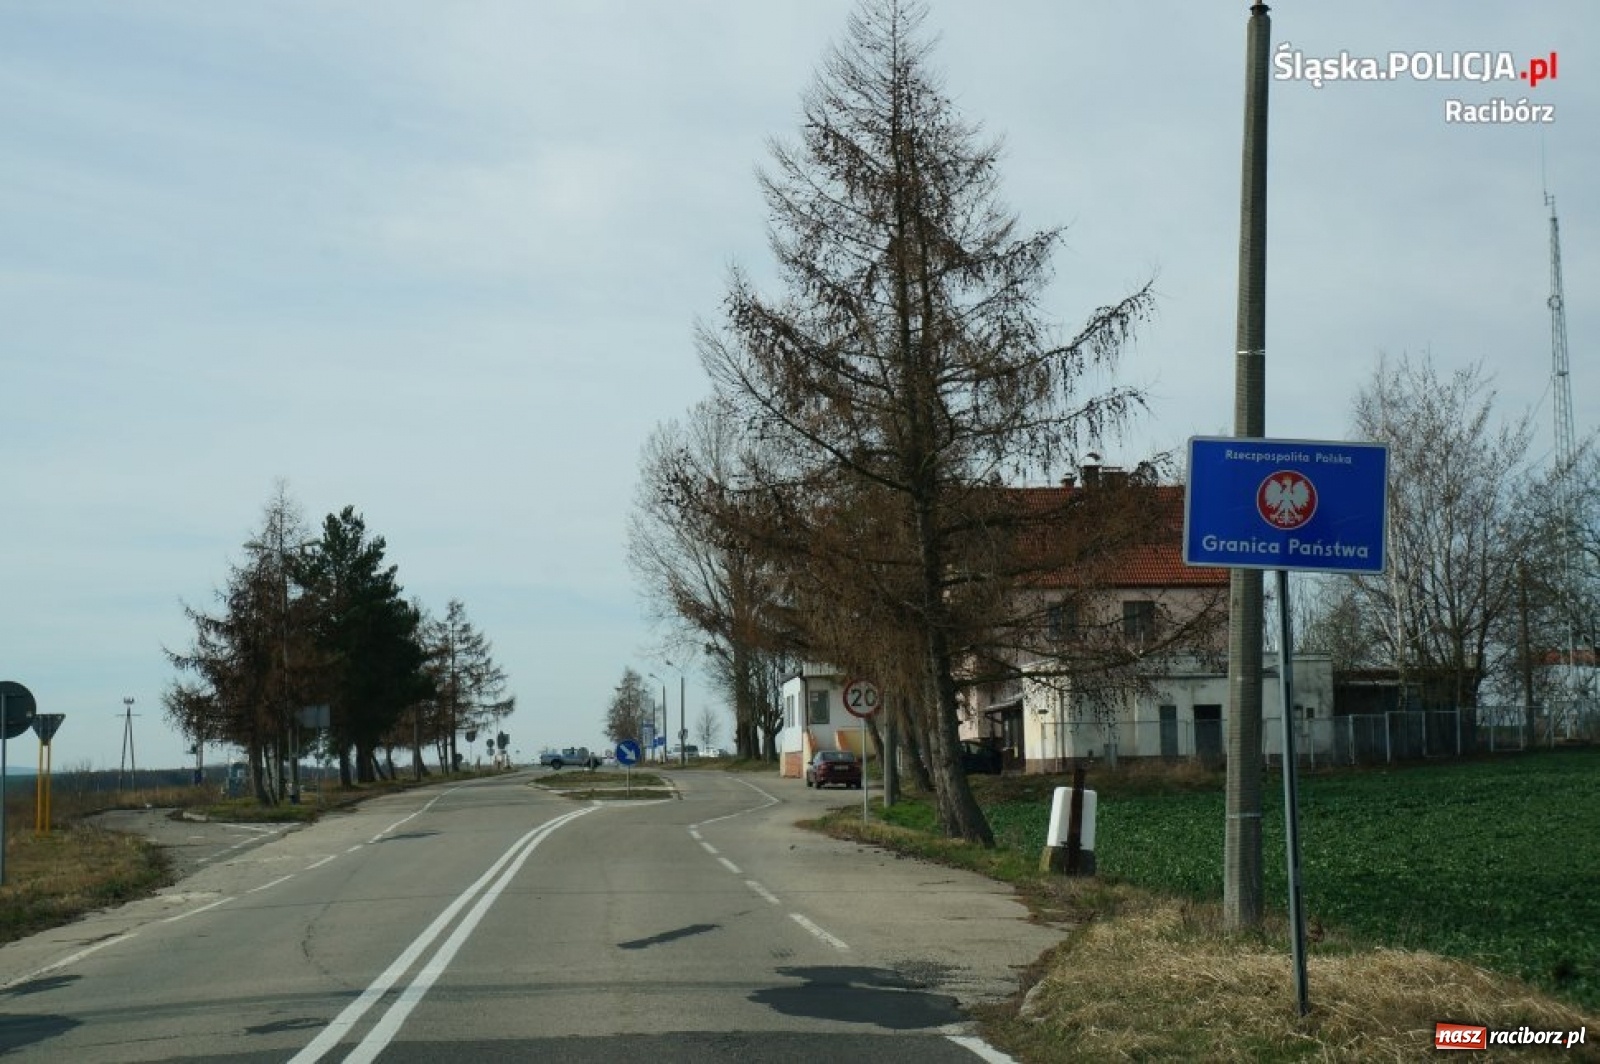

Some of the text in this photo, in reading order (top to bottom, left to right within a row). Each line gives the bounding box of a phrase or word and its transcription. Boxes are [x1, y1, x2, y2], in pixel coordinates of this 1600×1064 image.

[1225, 449, 1352, 465] Rzeczpospolita Polska
[1202, 534, 1369, 559] Granica Państwa
[850, 688, 877, 707] 20
